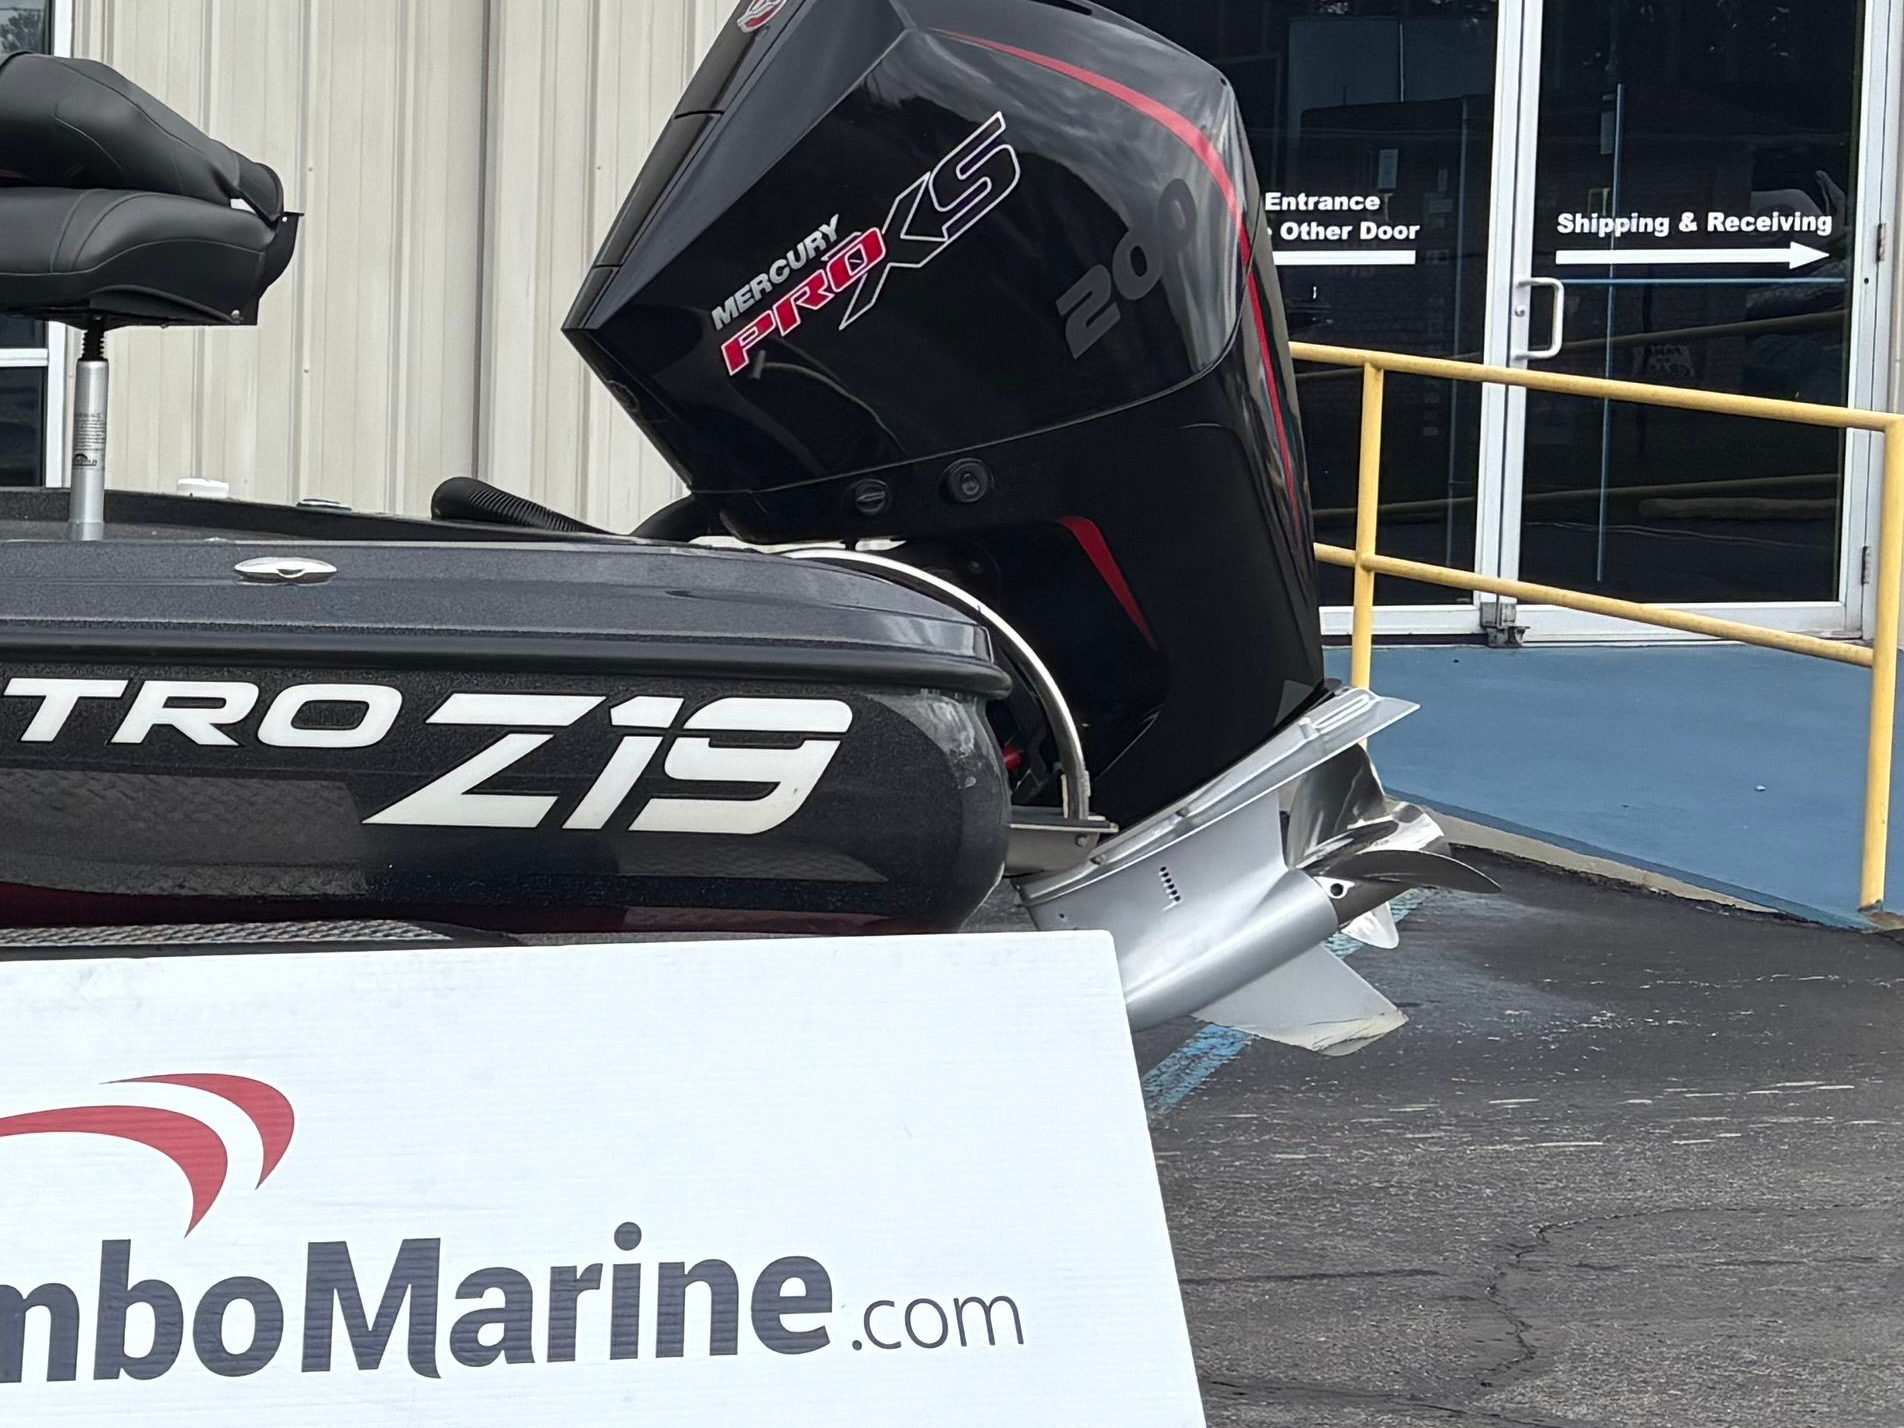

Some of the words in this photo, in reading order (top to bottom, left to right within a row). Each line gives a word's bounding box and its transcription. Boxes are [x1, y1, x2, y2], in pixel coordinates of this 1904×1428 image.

[1265, 192, 1381, 211] Entrance
[1280, 221, 1353, 241] Other
[1360, 221, 1421, 240] Door
[1557, 212, 1670, 238] Shipping
[1678, 212, 1698, 233] &
[1707, 211, 1833, 237] Receiving
[710, 214, 841, 331] MERCURY
[1056, 178, 1197, 360] 200
[364, 694, 855, 835] Z19
